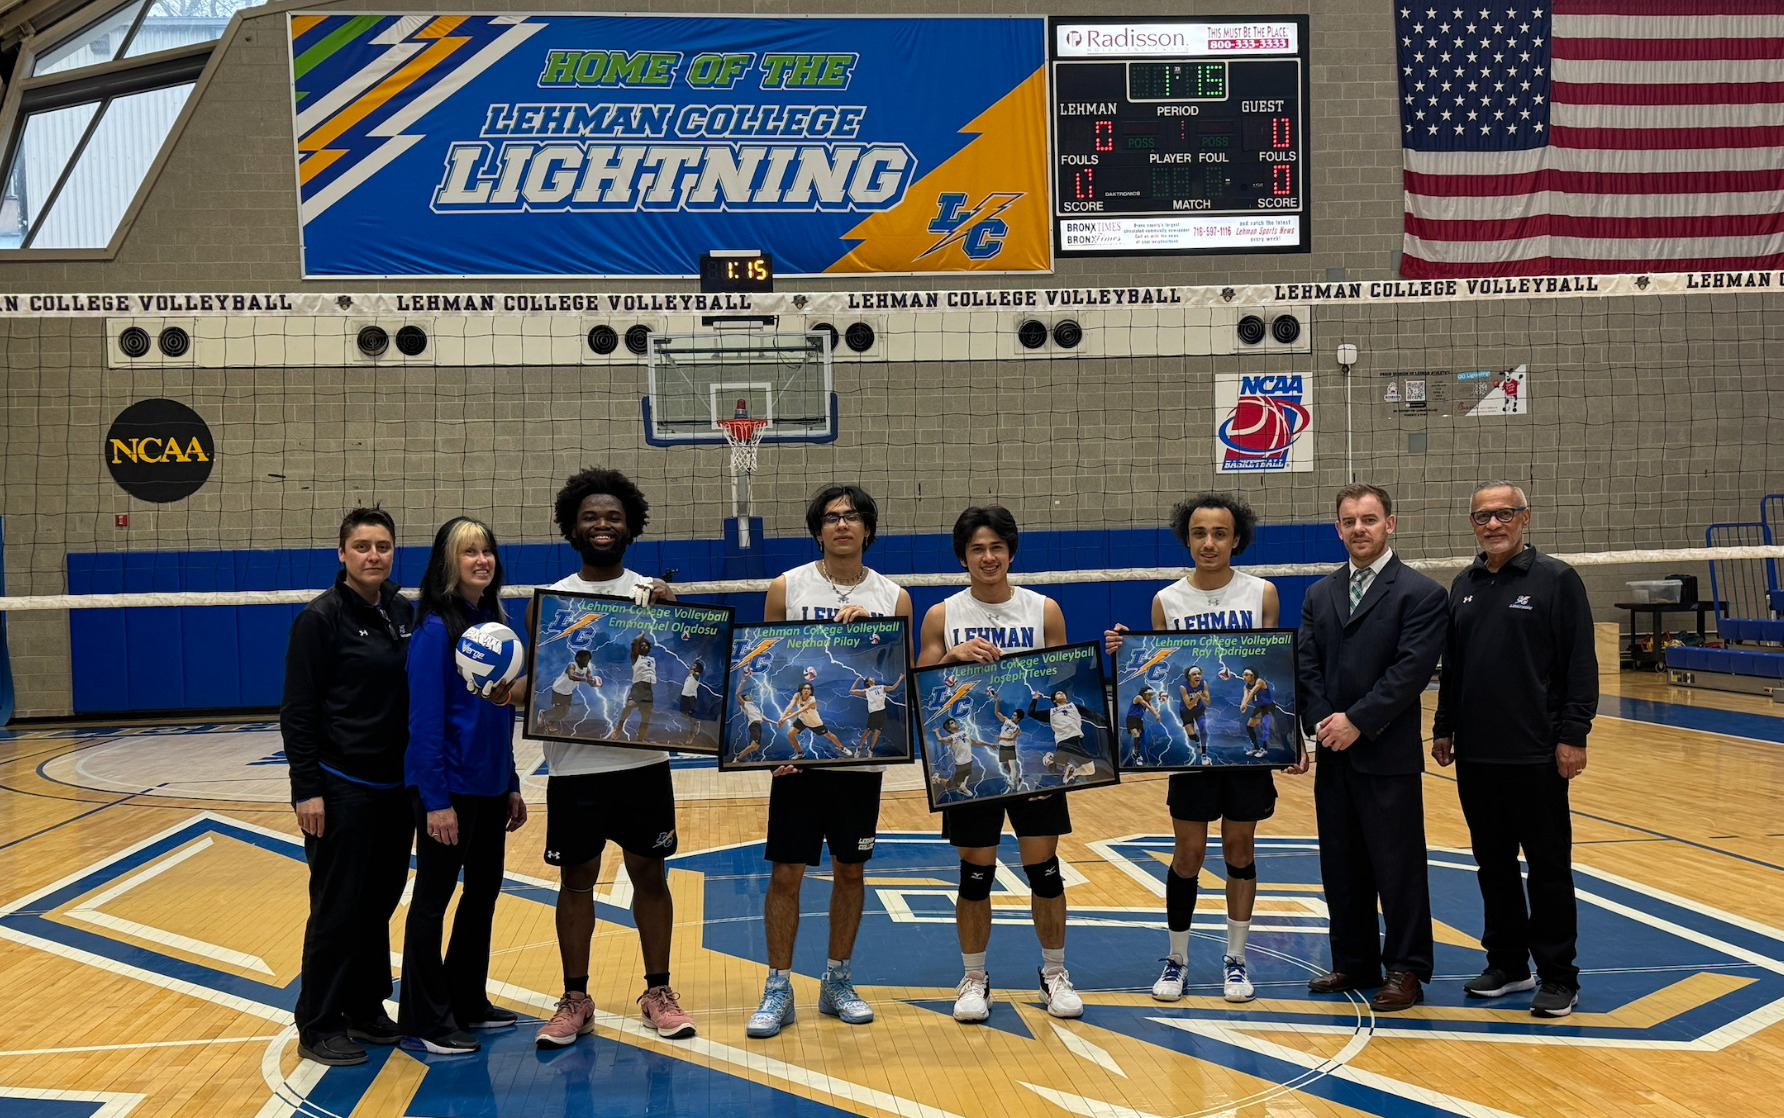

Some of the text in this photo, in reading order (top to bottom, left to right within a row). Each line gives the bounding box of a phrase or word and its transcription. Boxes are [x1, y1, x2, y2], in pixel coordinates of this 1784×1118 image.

[1208, 26, 1221, 38] THIS
[1222, 26, 1242, 38] MUST
[1243, 26, 1251, 37] BE
[1253, 26, 1264, 37] THE
[1209, 39, 1287, 50] 800-333-3333
[539, 49, 860, 90] HOME OF THE
[1060, 102, 1118, 115] LEHMAN
[1157, 105, 1199, 117] PERIOD
[1241, 100, 1284, 113] GUEST
[480, 103, 867, 138] LEHMAN COLLEGE
[1061, 154, 1099, 165] FOULS
[1149, 152, 1229, 163] PLAYER FOUL
[1259, 151, 1296, 162] FOULS
[430, 141, 918, 214] LIGHTNING
[1063, 201, 1104, 212] SCORE
[1173, 199, 1211, 210] MATCH
[1257, 198, 1297, 208] SCORE
[1236, 226, 1295, 236] Lehman Sports News
[728, 259, 767, 281] 1:15
[1275, 275, 1599, 301] LEHMAN COLLEGE VOLLEYBALL
[1687, 272, 1771, 290] LEHMAN
[29, 294, 129, 313] COLLEGE
[138, 293, 293, 312] VOLLEYBALL
[396, 293, 752, 312] LEHMAN COLLEGE VOLLEYBALL
[848, 287, 1181, 310] LEHMAN COLLEGE VOLLEYBALL
[1240, 375, 1303, 395] NCAA
[110, 436, 209, 464] NCAA
[1223, 459, 1284, 469] BASKETBALL
[581, 599, 729, 622] Lehman College Volleyball
[608, 617, 718, 636] Emmanuel Oladosu
[756, 621, 900, 638] Lehman College Volleyball
[462, 639, 485, 660] Verge
[833, 636, 860, 649] Pilay
[1155, 634, 1292, 648] Lehman College Volleyball
[1192, 647, 1267, 658] Ray Rodriguez
[954, 646, 1095, 677] Lehman College Volleyball
[989, 665, 1058, 685] Joseph Teves
